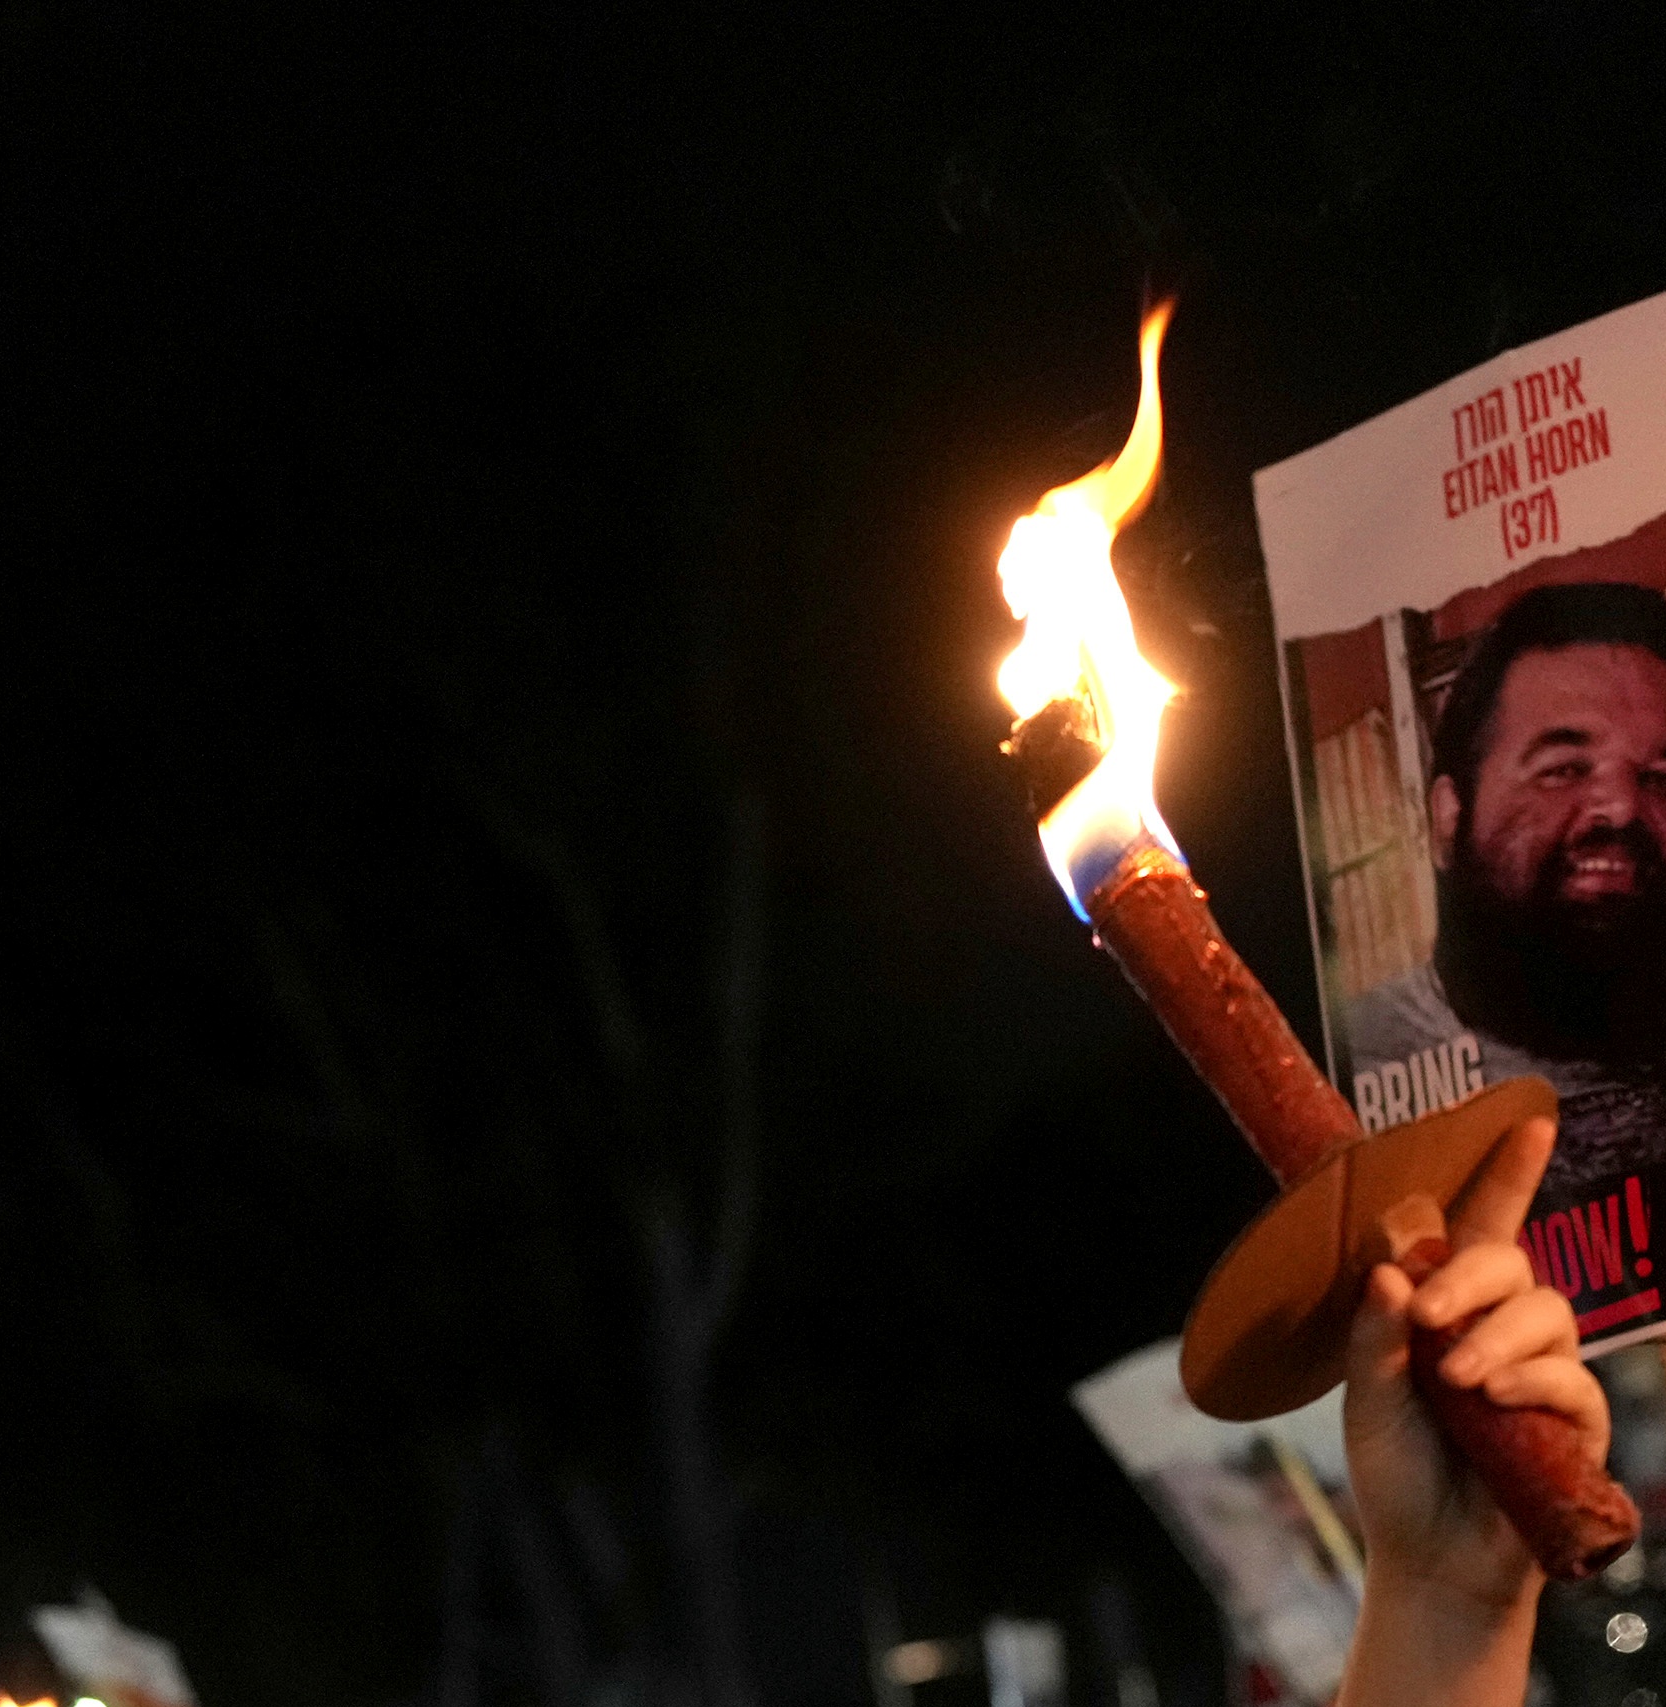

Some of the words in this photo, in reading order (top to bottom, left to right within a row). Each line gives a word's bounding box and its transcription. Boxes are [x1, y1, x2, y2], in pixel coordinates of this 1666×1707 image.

[1452, 387, 1508, 462] הורן
[1513, 357, 1586, 433] איתן
[1443, 442, 1520, 520] EITAN
[1525, 407, 1611, 484] HORN
[1501, 485, 1560, 560] (37)
[1353, 1034, 1483, 1139] BRING
